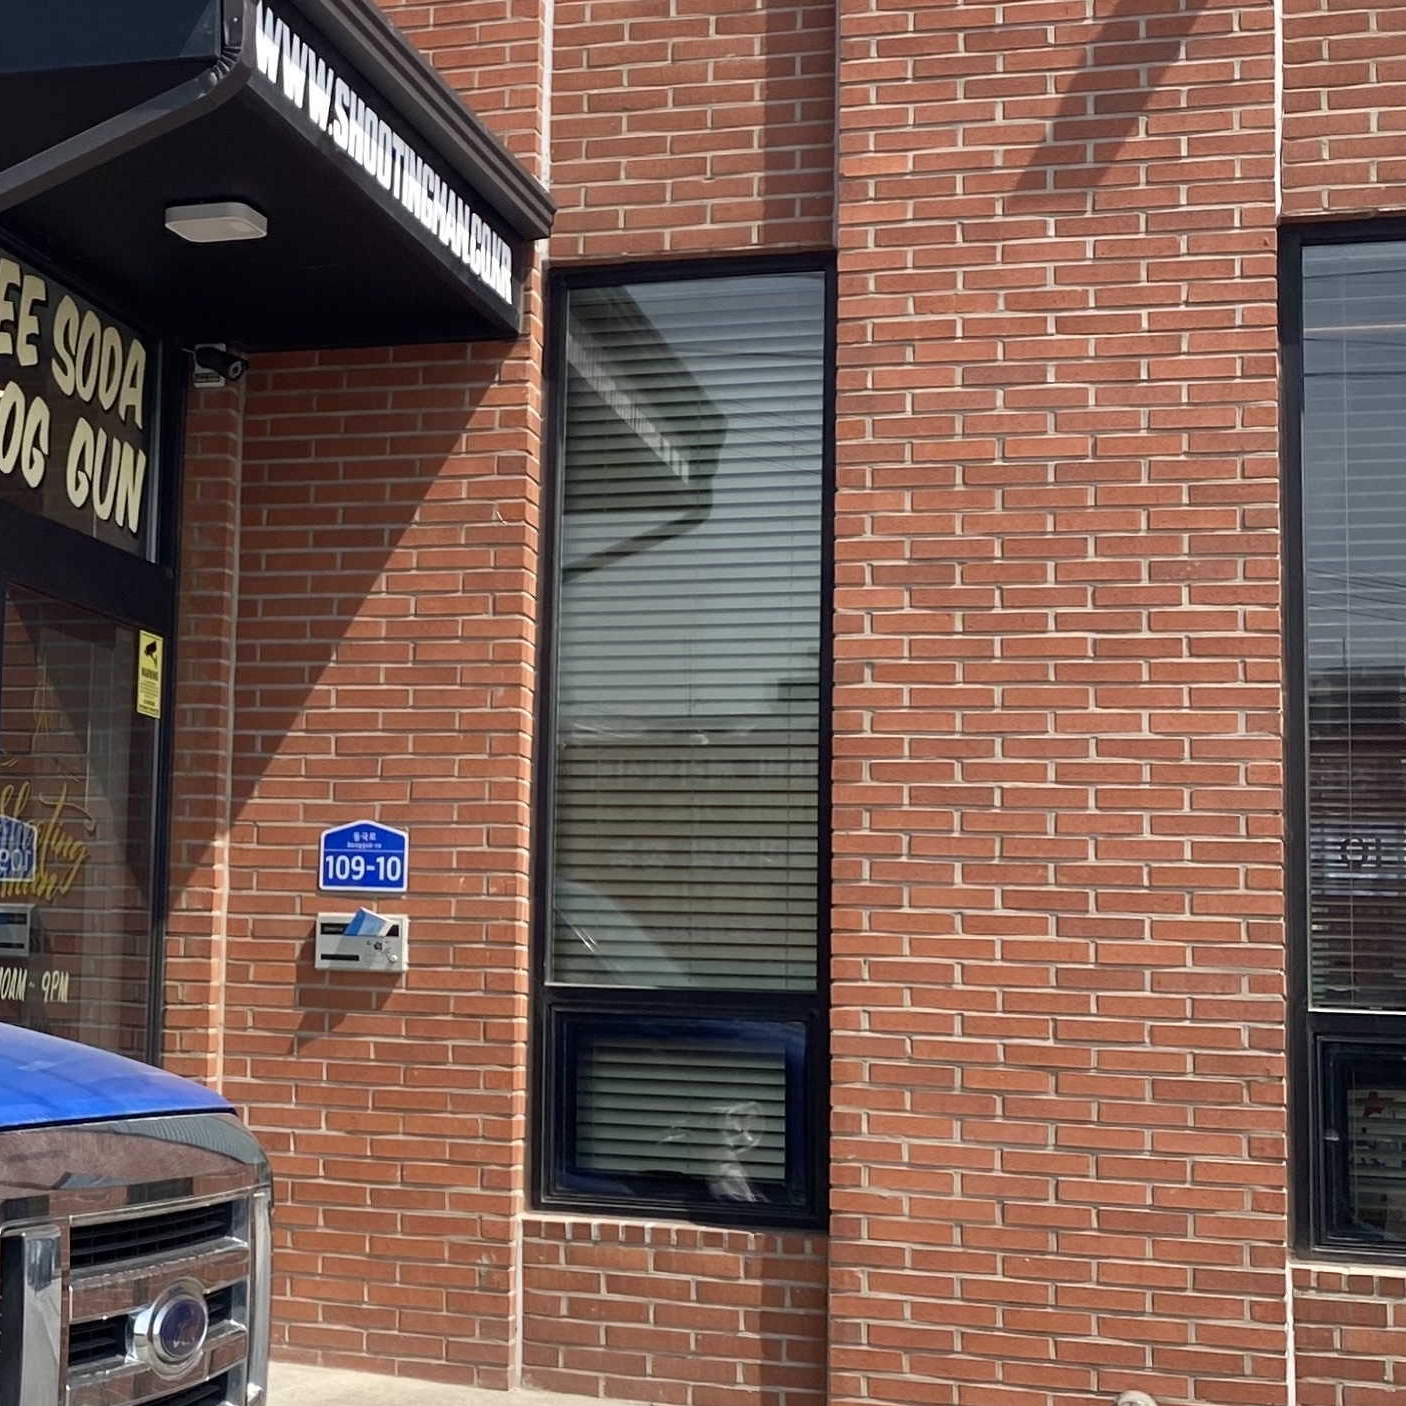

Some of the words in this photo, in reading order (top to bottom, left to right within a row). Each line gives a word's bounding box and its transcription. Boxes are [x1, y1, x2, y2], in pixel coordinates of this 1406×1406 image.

[51, 295, 146, 429] SODA
[66, 417, 146, 533] GUN
[353, 831, 378, 842] 동국로
[325, 855, 401, 881] 109-10
[41, 970, 70, 1004] 9PM
